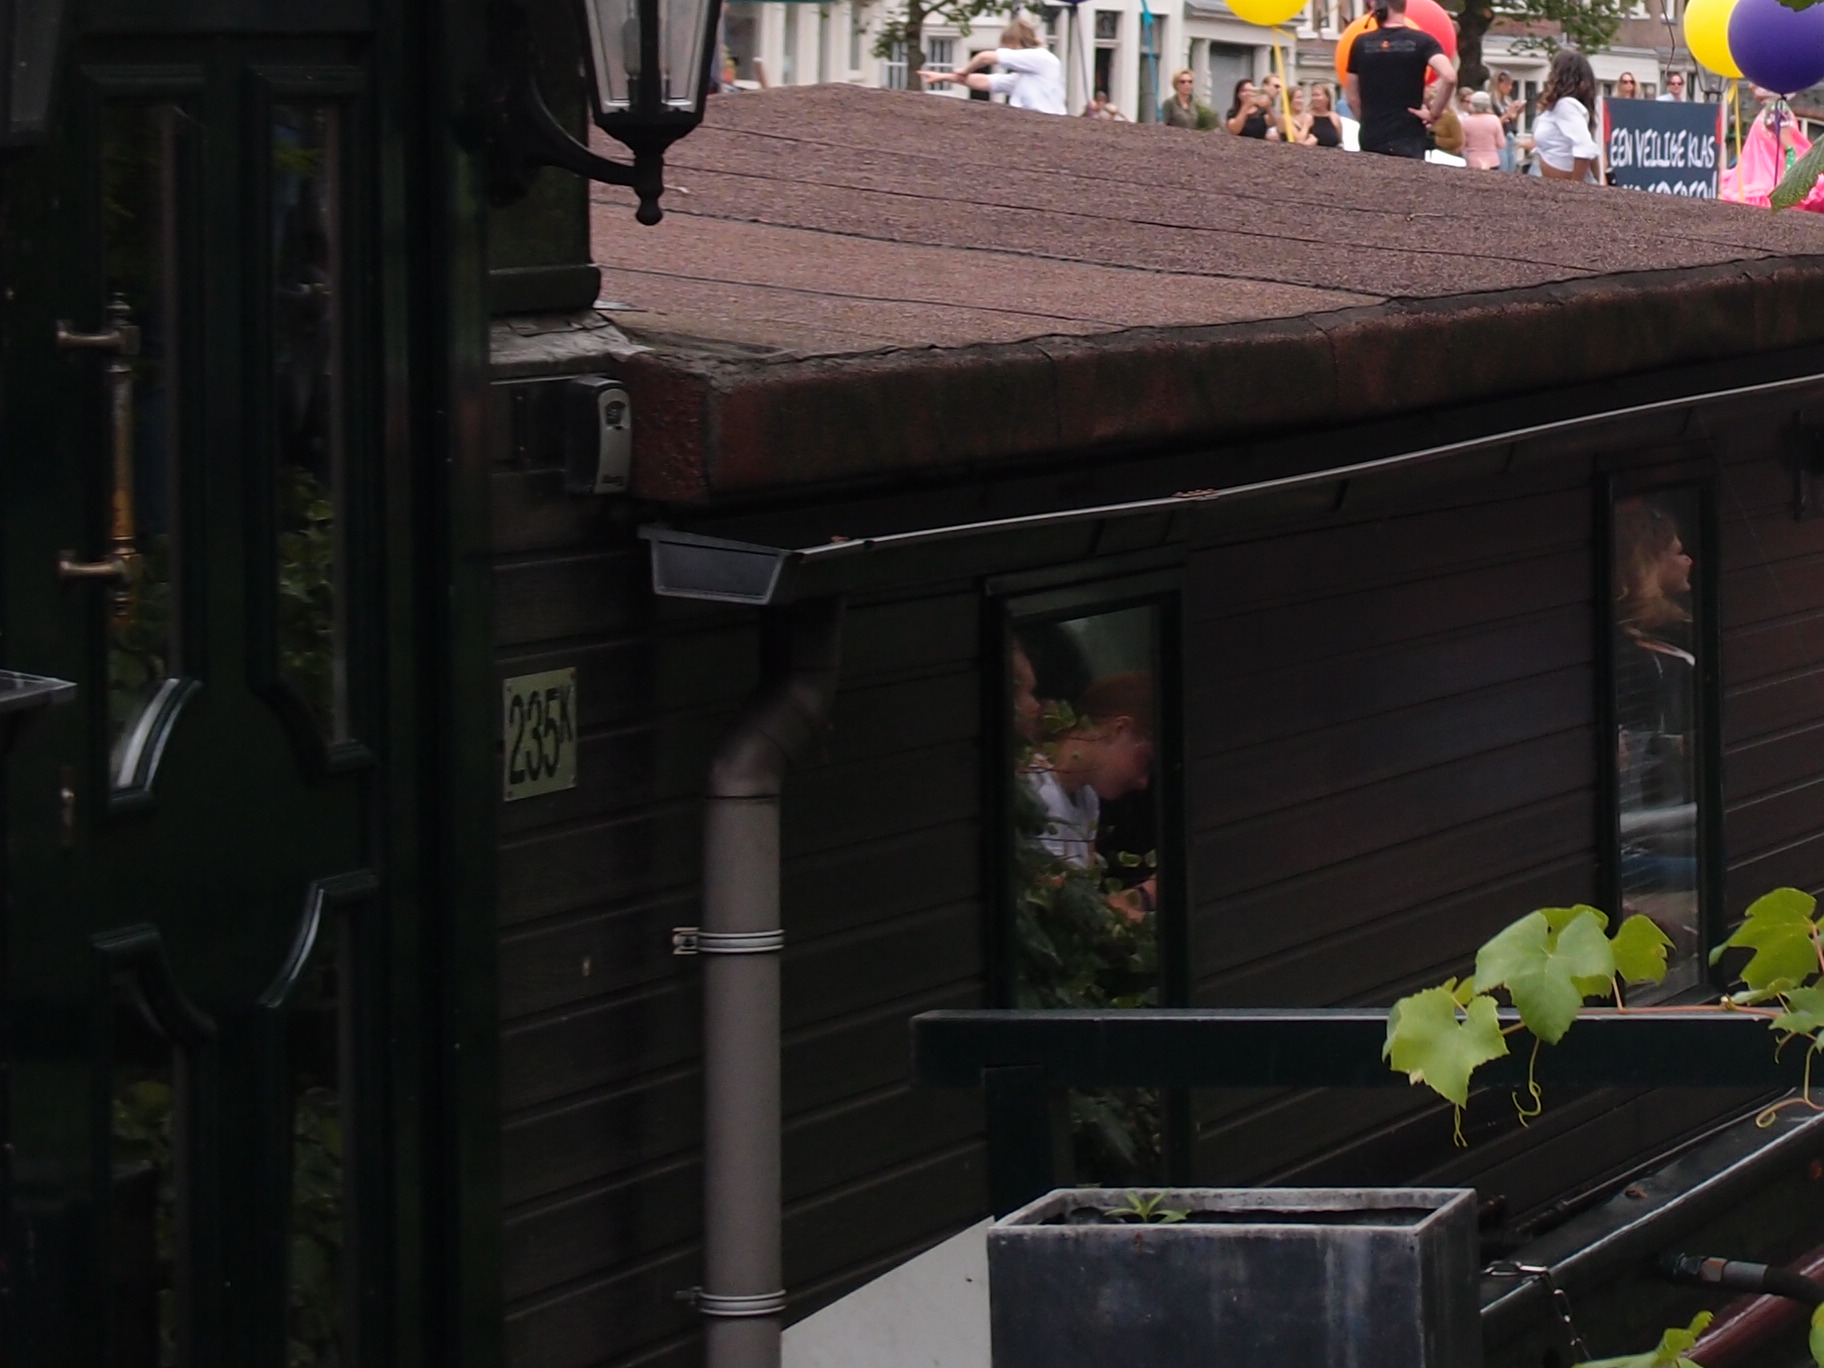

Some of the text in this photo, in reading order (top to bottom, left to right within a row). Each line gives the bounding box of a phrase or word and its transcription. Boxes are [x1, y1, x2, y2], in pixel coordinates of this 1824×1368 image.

[1610, 127, 1716, 169] EEN VEILIGE KLAS
